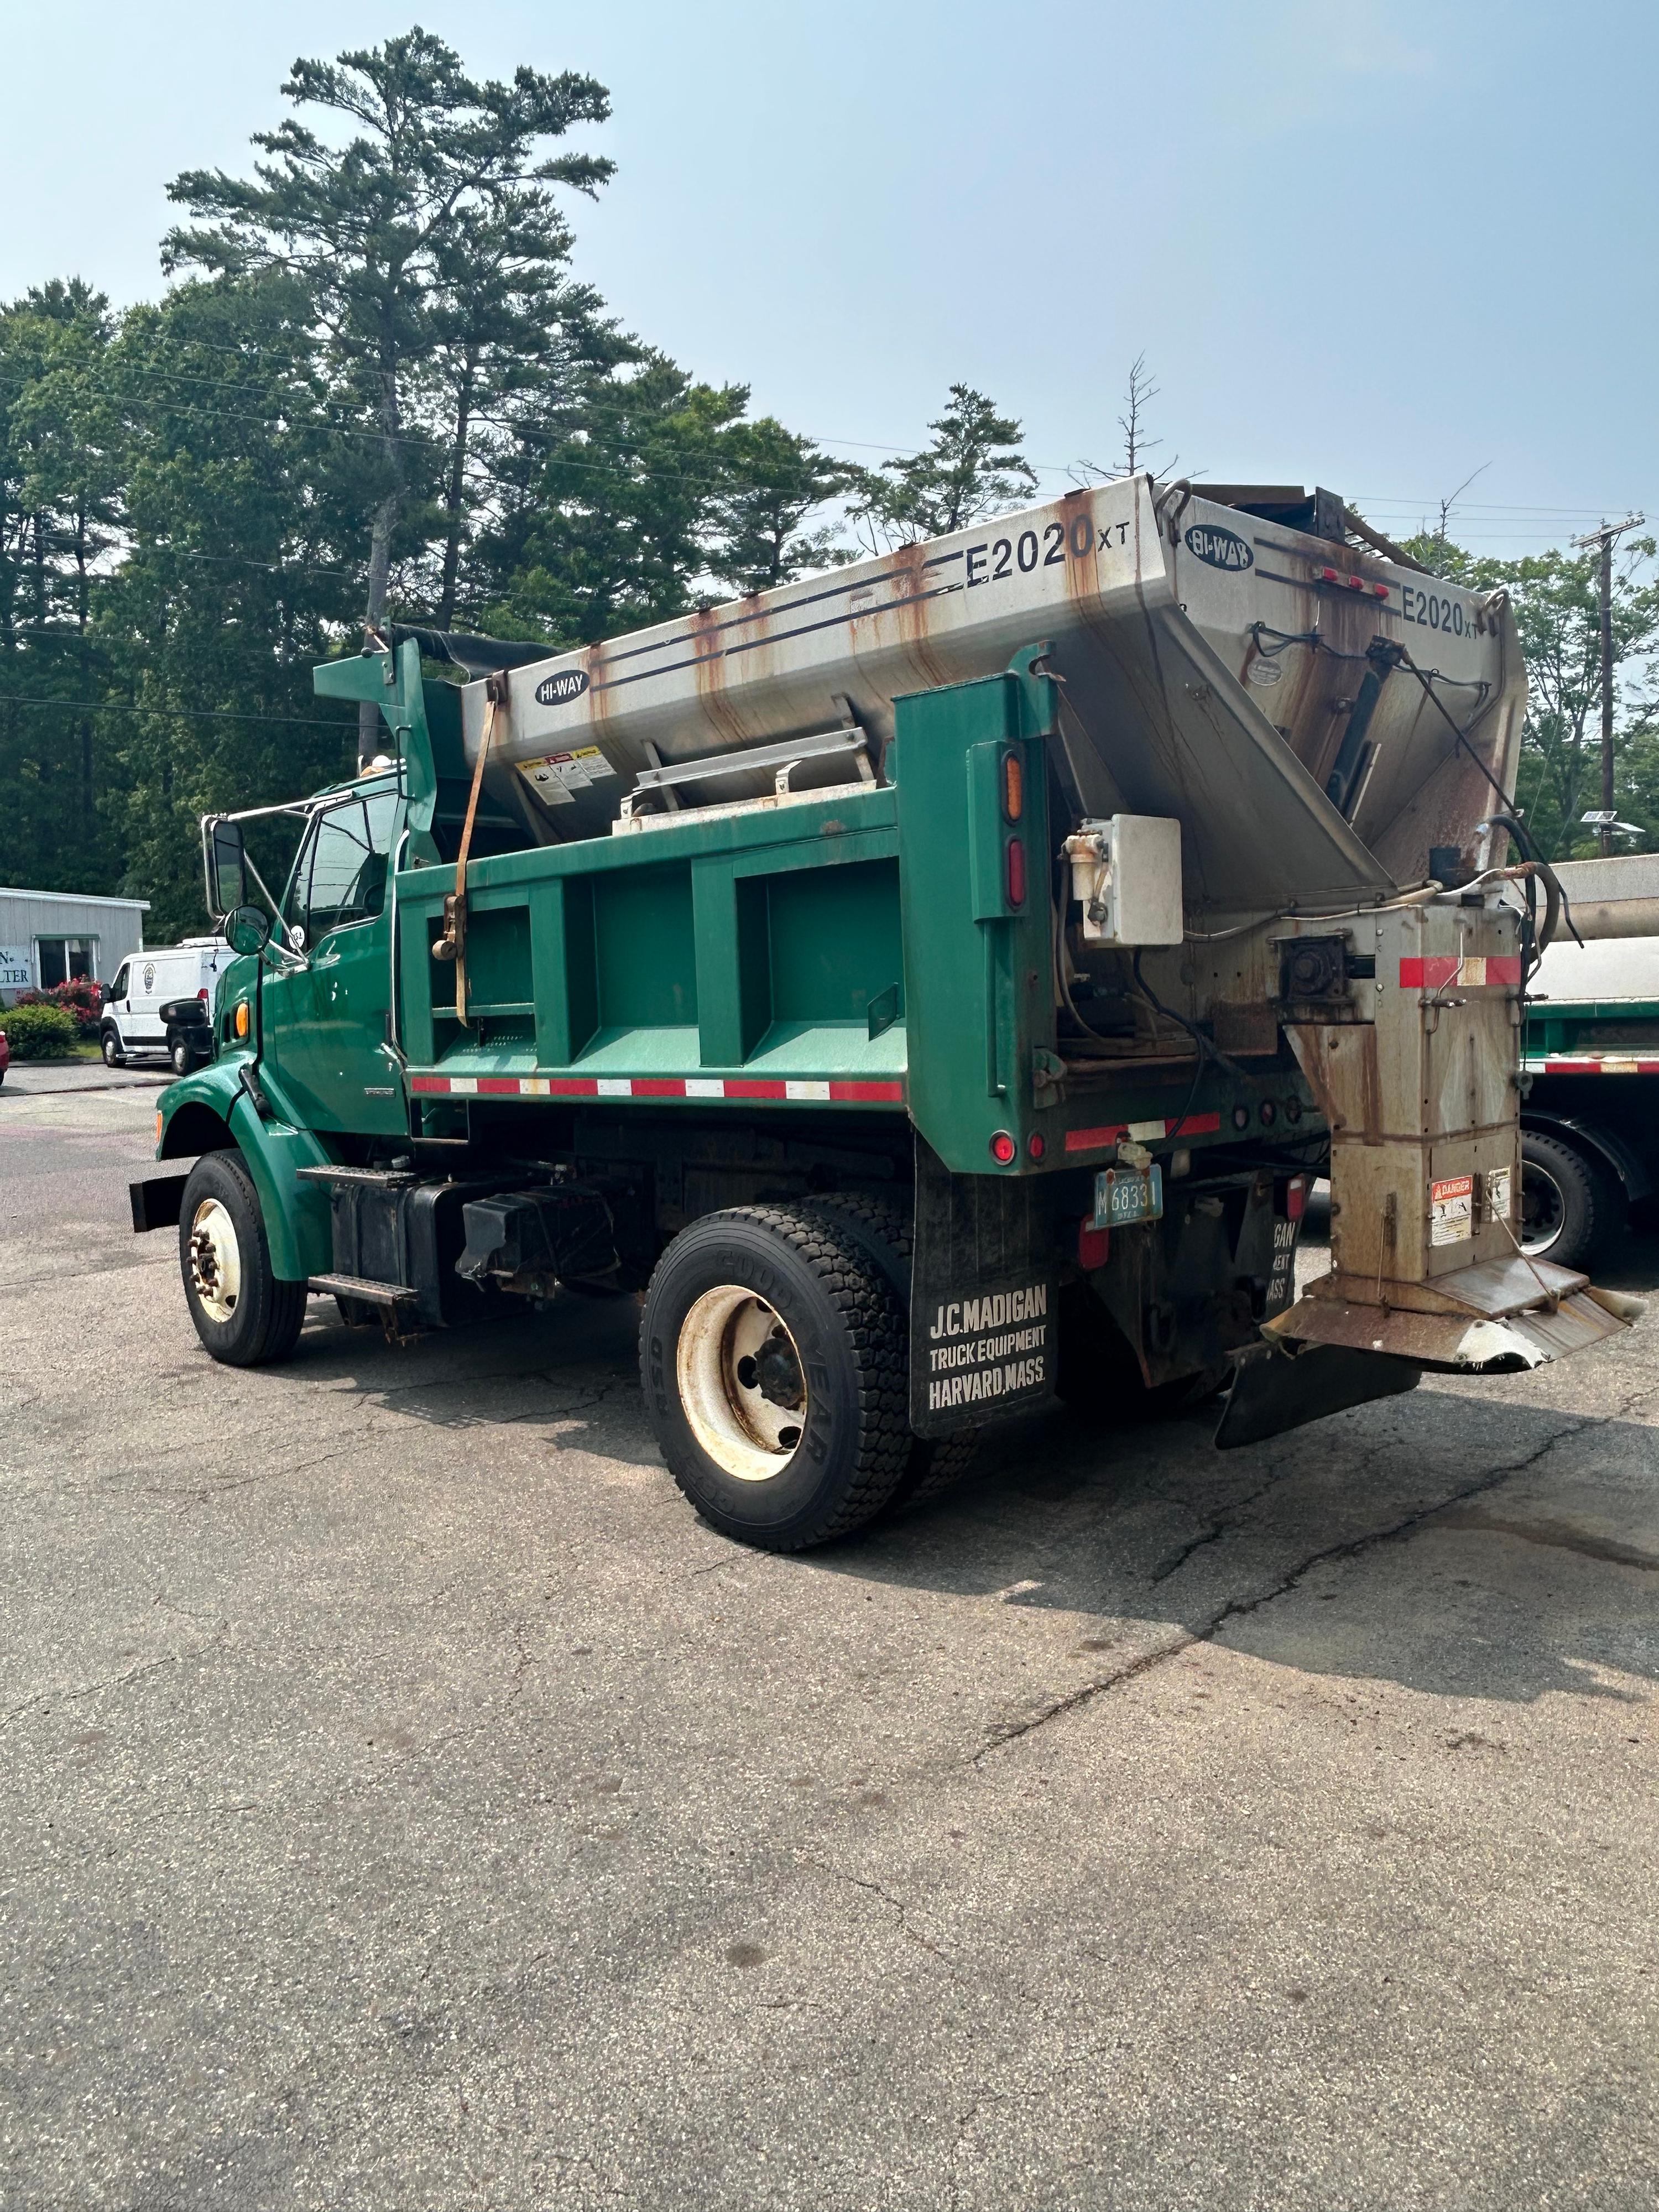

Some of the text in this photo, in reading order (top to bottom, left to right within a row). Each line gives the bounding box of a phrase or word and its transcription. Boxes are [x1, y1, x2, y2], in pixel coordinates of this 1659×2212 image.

[541, 674, 583, 702] HI-WAY
[930, 1324, 1047, 1371] TRUCK EQUIPMENT
